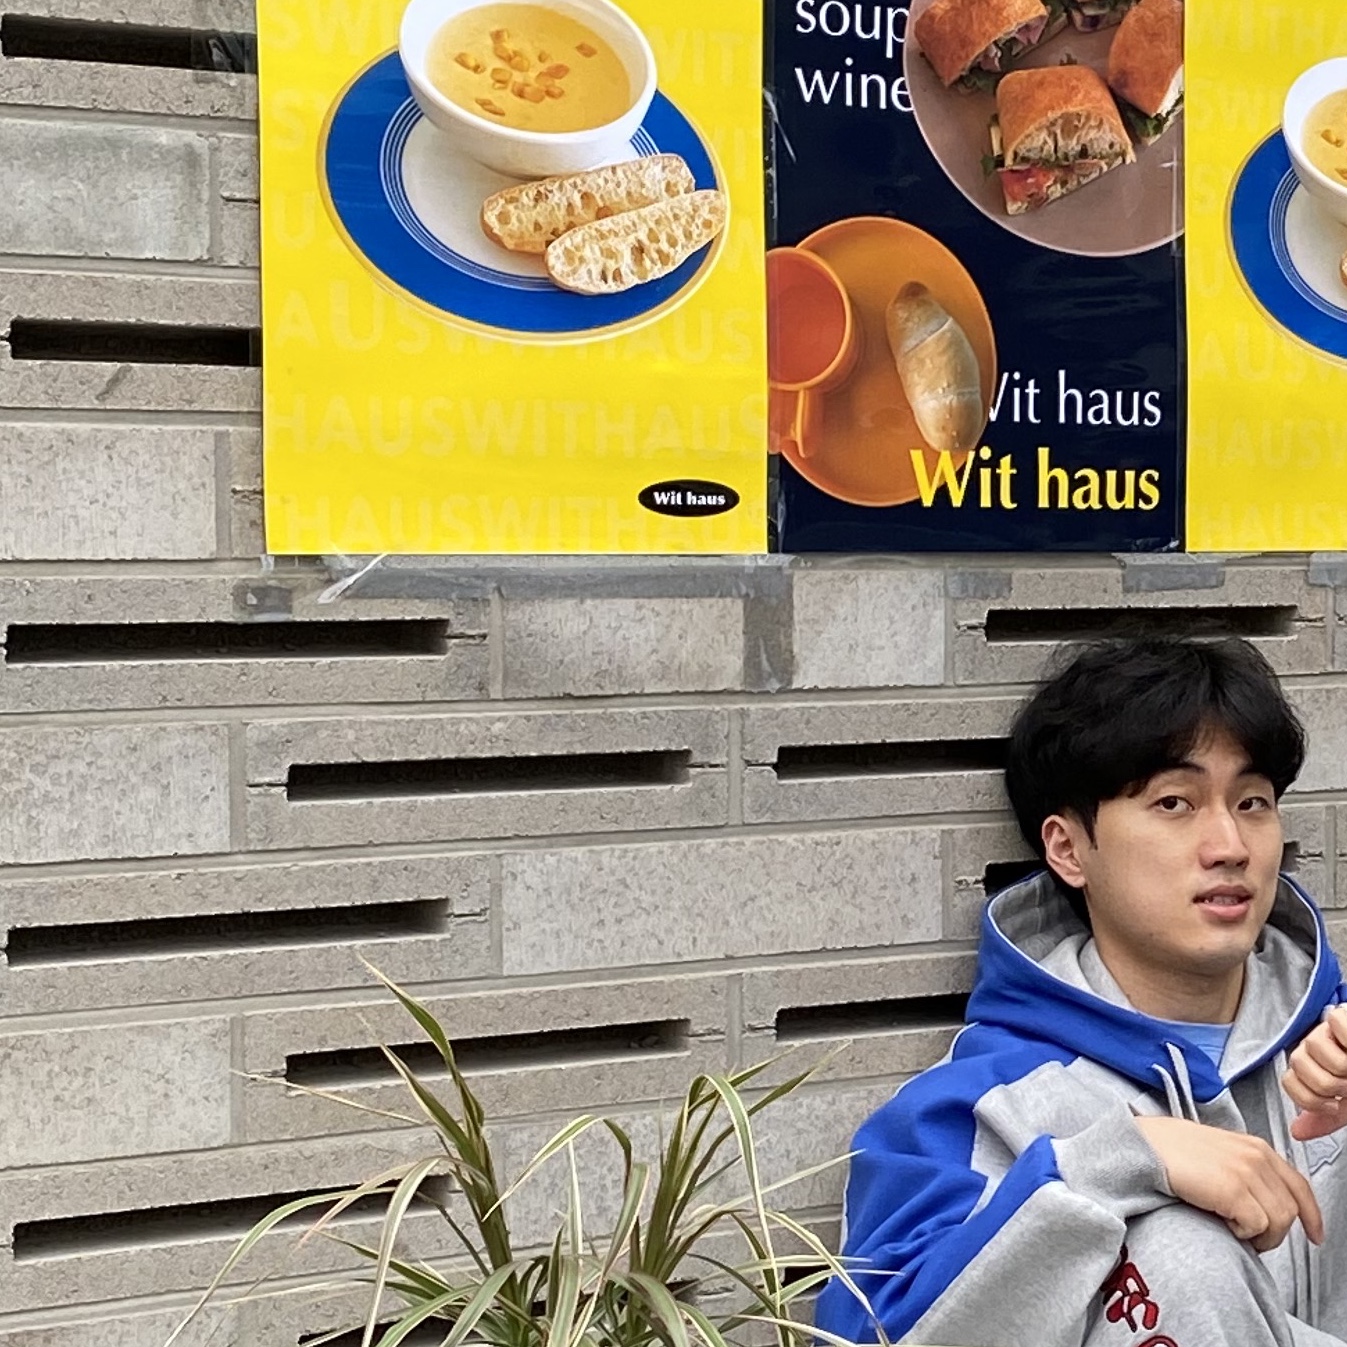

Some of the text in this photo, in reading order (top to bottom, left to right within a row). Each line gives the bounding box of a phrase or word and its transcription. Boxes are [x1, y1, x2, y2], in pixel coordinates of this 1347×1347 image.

[795, 0, 908, 58] soup
[794, 57, 914, 112] wine
[1058, 369, 1161, 427] haus
[653, 490, 727, 506] Wit haus
[909, 446, 1160, 510] Wit haus
